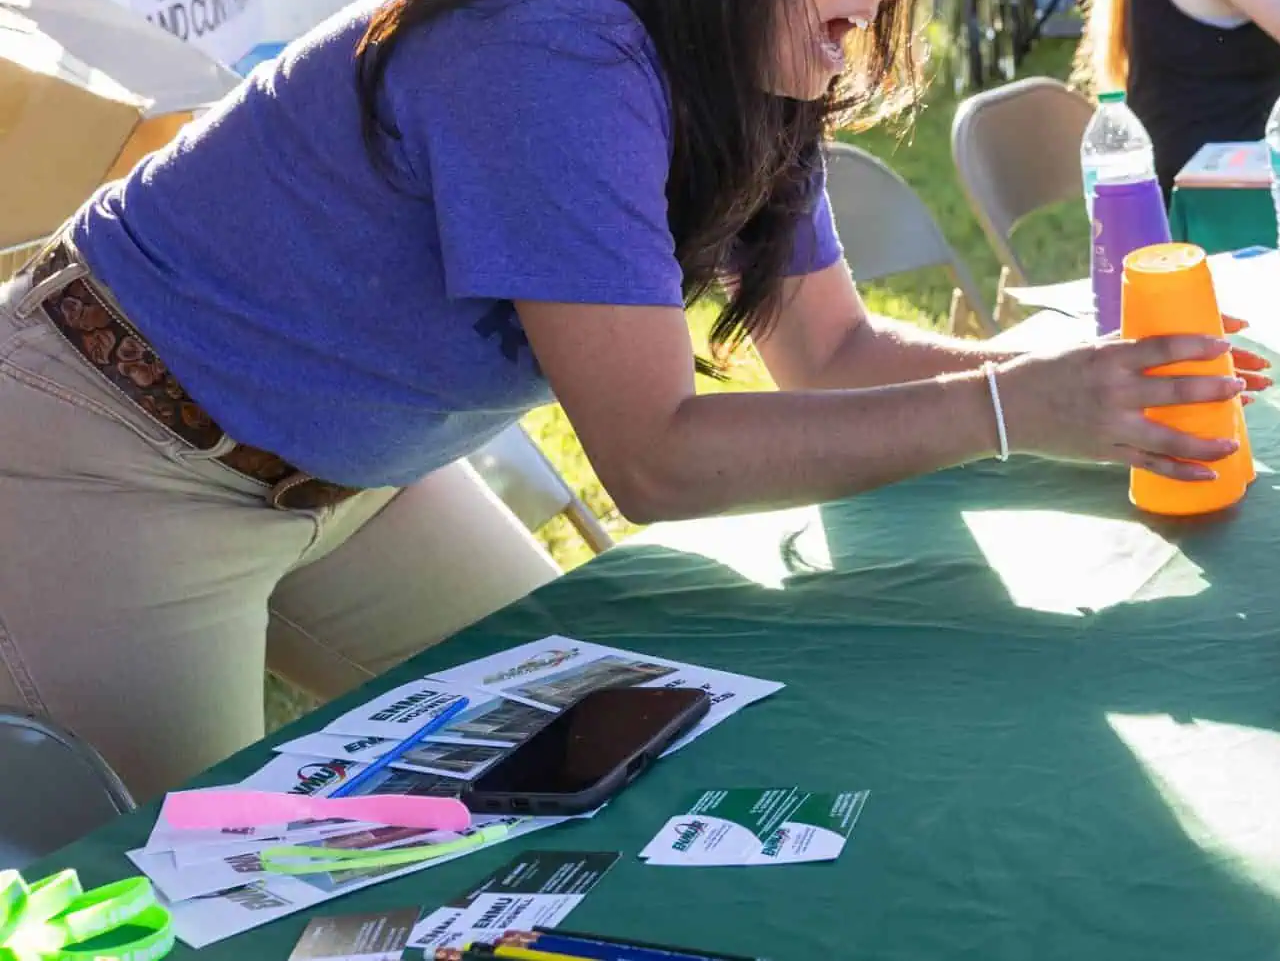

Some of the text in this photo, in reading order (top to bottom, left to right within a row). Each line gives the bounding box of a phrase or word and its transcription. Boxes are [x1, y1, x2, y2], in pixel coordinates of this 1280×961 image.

[146, 2, 190, 42] ND
[367, 690, 438, 722] ENMU
[472, 897, 513, 928] ENMU
